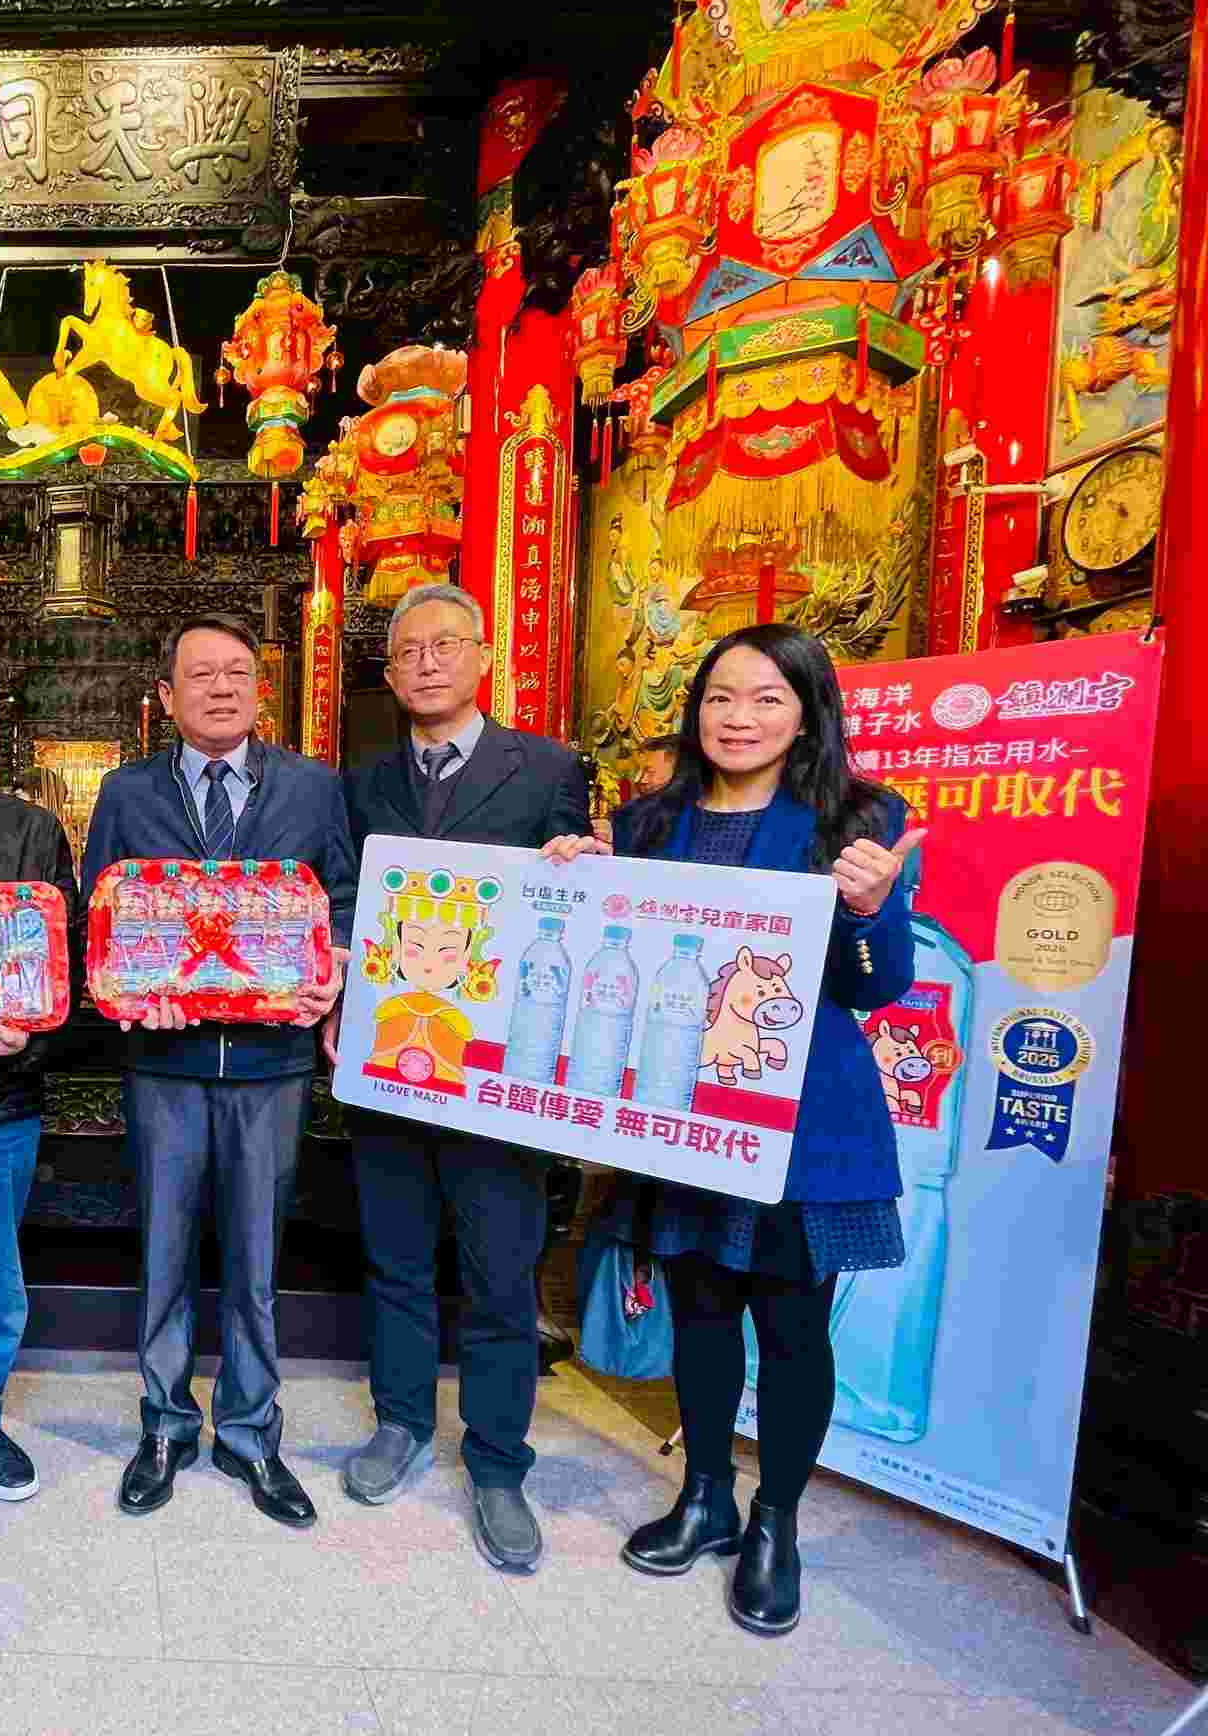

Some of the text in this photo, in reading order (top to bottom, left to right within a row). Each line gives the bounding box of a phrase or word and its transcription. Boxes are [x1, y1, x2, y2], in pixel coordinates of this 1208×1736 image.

[839, 682, 913, 709] 海洋
[1026, 928, 1079, 941] GOLD
[1016, 1050, 1060, 1068] 2026
[379, 1083, 410, 1098] LOVE
[413, 1087, 448, 1105] MAZU
[476, 1079, 761, 1164] 台鹽傳愛 無可取代
[999, 1096, 1069, 1124] TASTE
